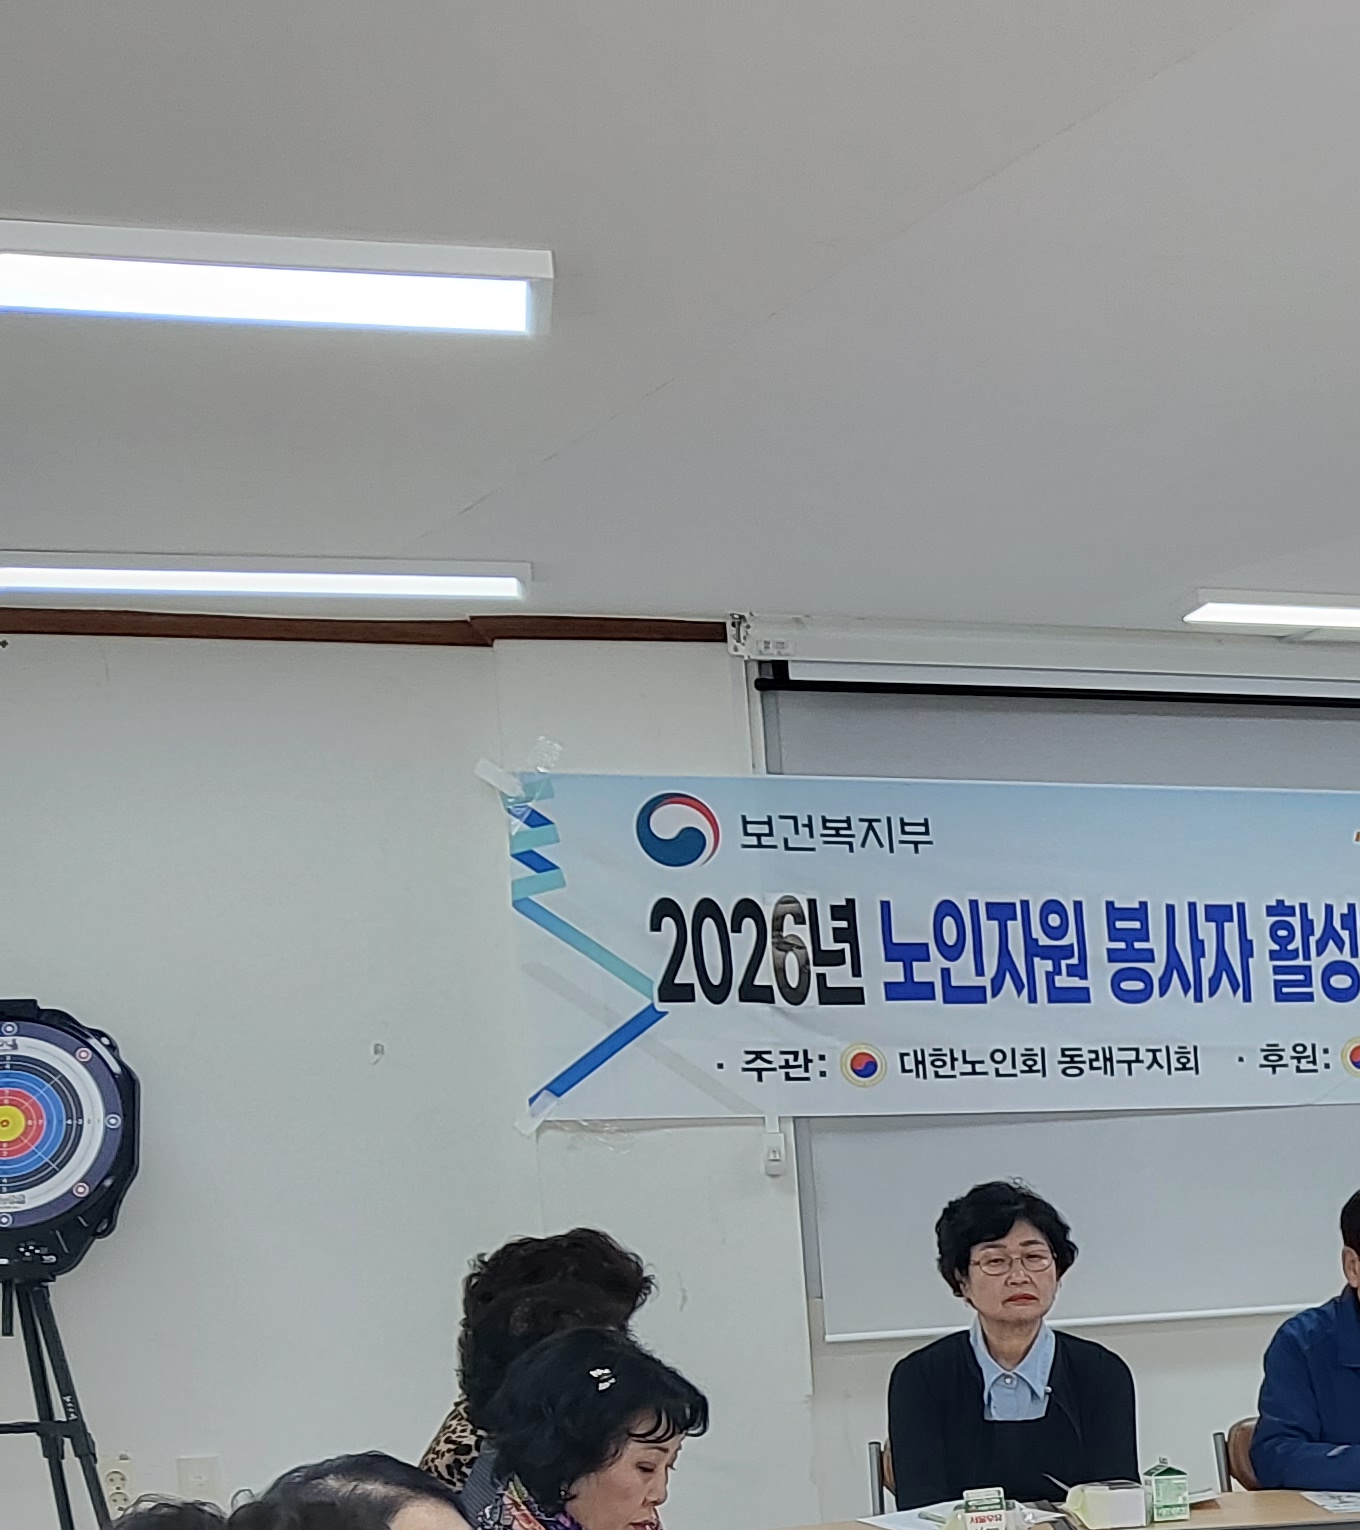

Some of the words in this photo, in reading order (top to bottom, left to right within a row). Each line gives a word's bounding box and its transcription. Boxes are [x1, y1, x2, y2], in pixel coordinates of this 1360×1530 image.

[740, 814, 934, 855] 보건복지부
[649, 894, 867, 1006] 2026년
[880, 898, 1092, 1005] 노인자원
[1105, 900, 1255, 1005] 봉사자
[740, 1048, 828, 1084] 주관:
[899, 1046, 1048, 1081] 대한노인회
[1056, 1044, 1202, 1078] 동래구지회
[1257, 1041, 1332, 1075] 후원:
